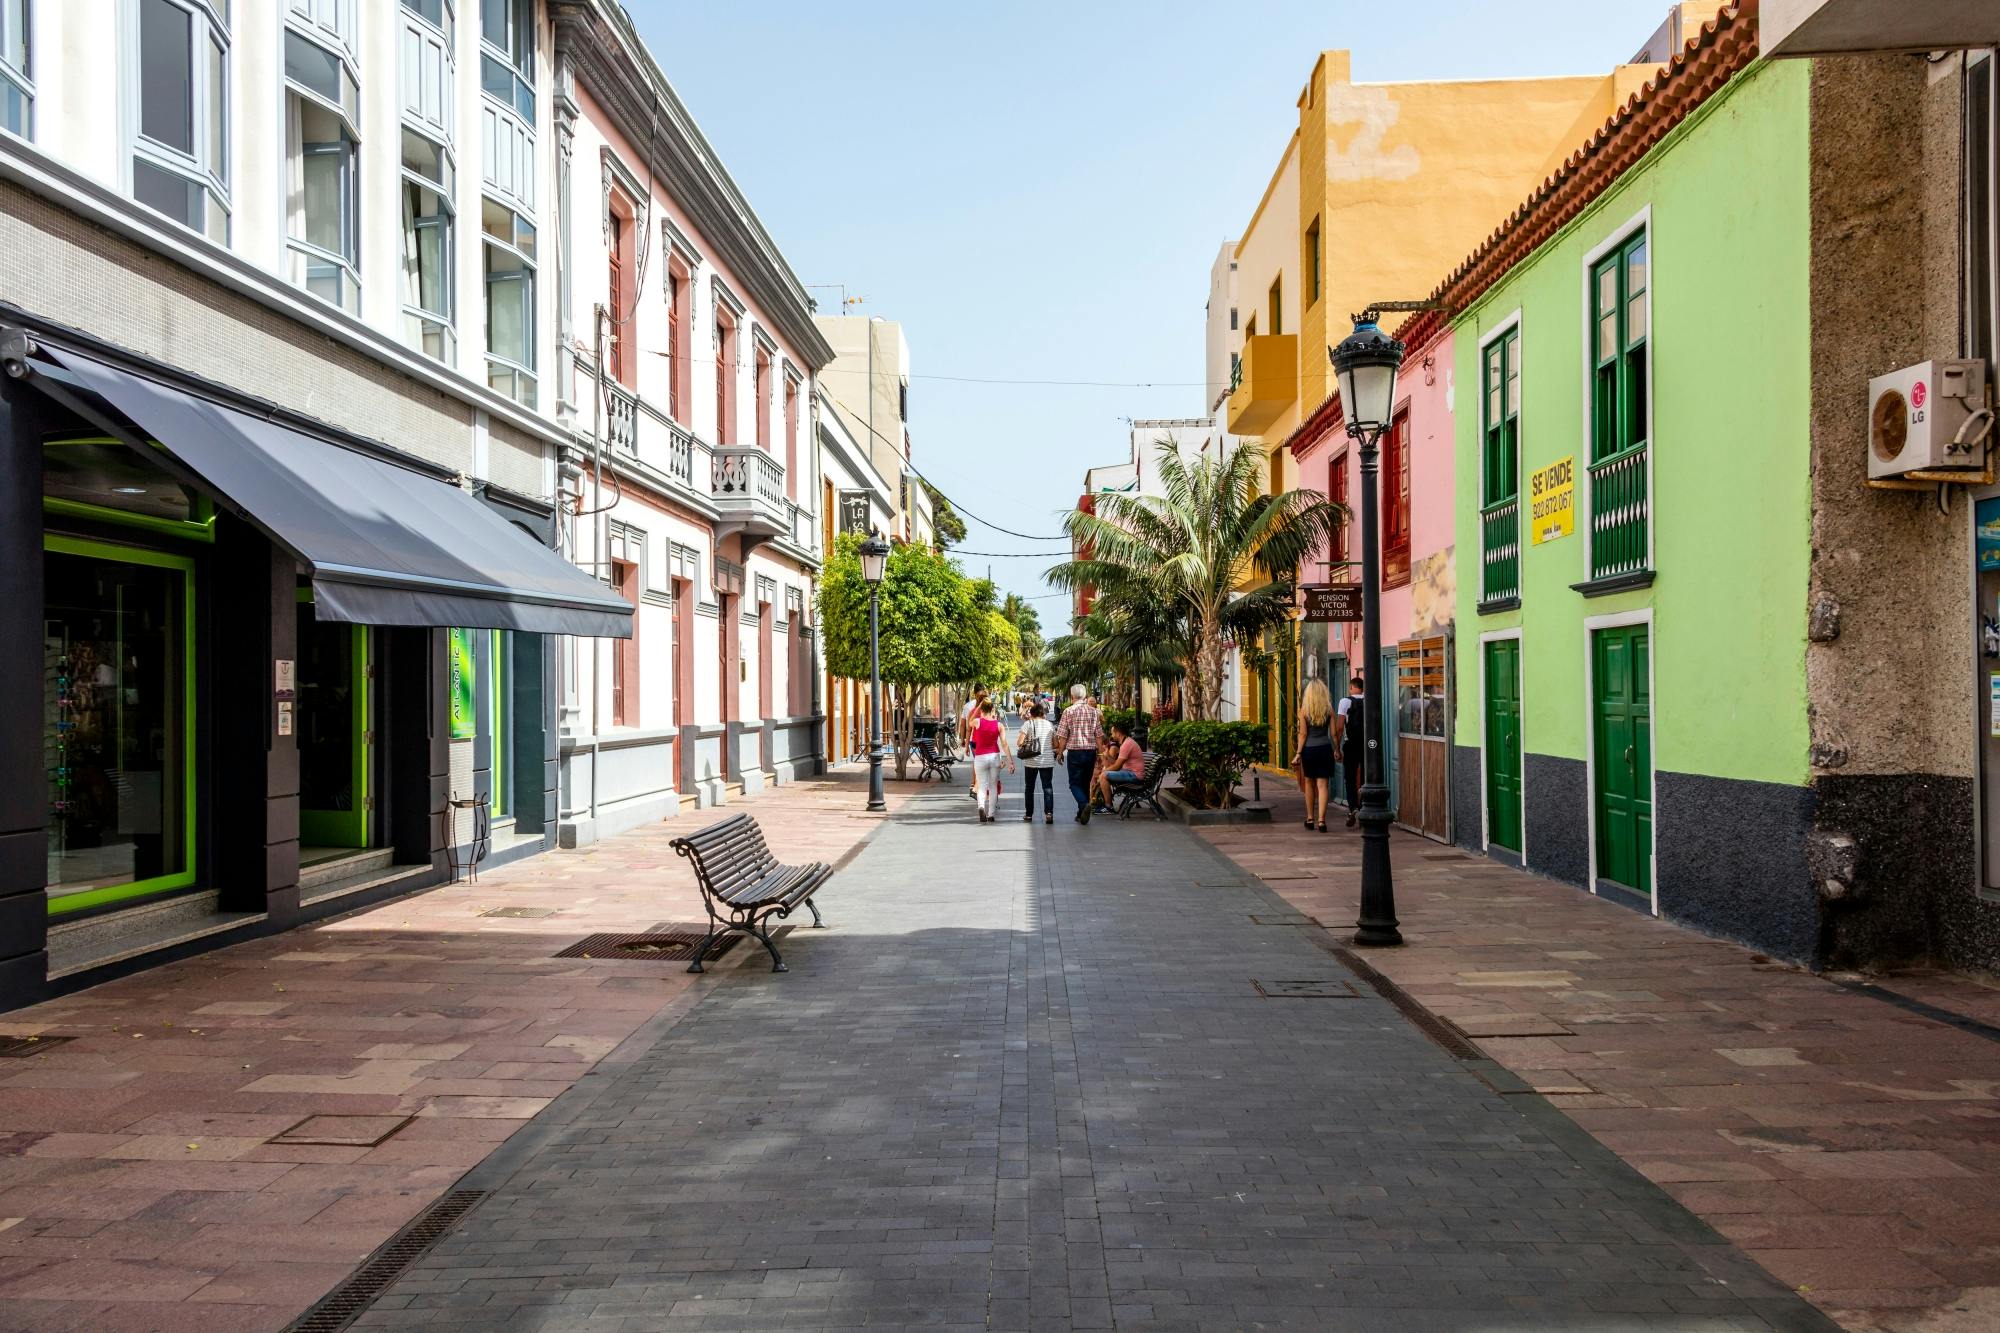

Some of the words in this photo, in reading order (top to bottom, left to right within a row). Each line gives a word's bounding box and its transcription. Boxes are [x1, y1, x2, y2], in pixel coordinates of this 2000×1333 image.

[1912, 411, 1925, 424] LG
[1532, 472, 1543, 496] SE
[1544, 459, 1573, 491] VENDE
[1533, 501, 1545, 520] 922
[1545, 496, 1558, 516] 872
[1559, 490, 1573, 511] 067
[852, 507, 864, 519] LA
[1317, 594, 1350, 602] PENSION
[1320, 601, 1348, 609] VICTOR
[1311, 609, 1325, 617] 922
[1327, 609, 1354, 617] 871335
